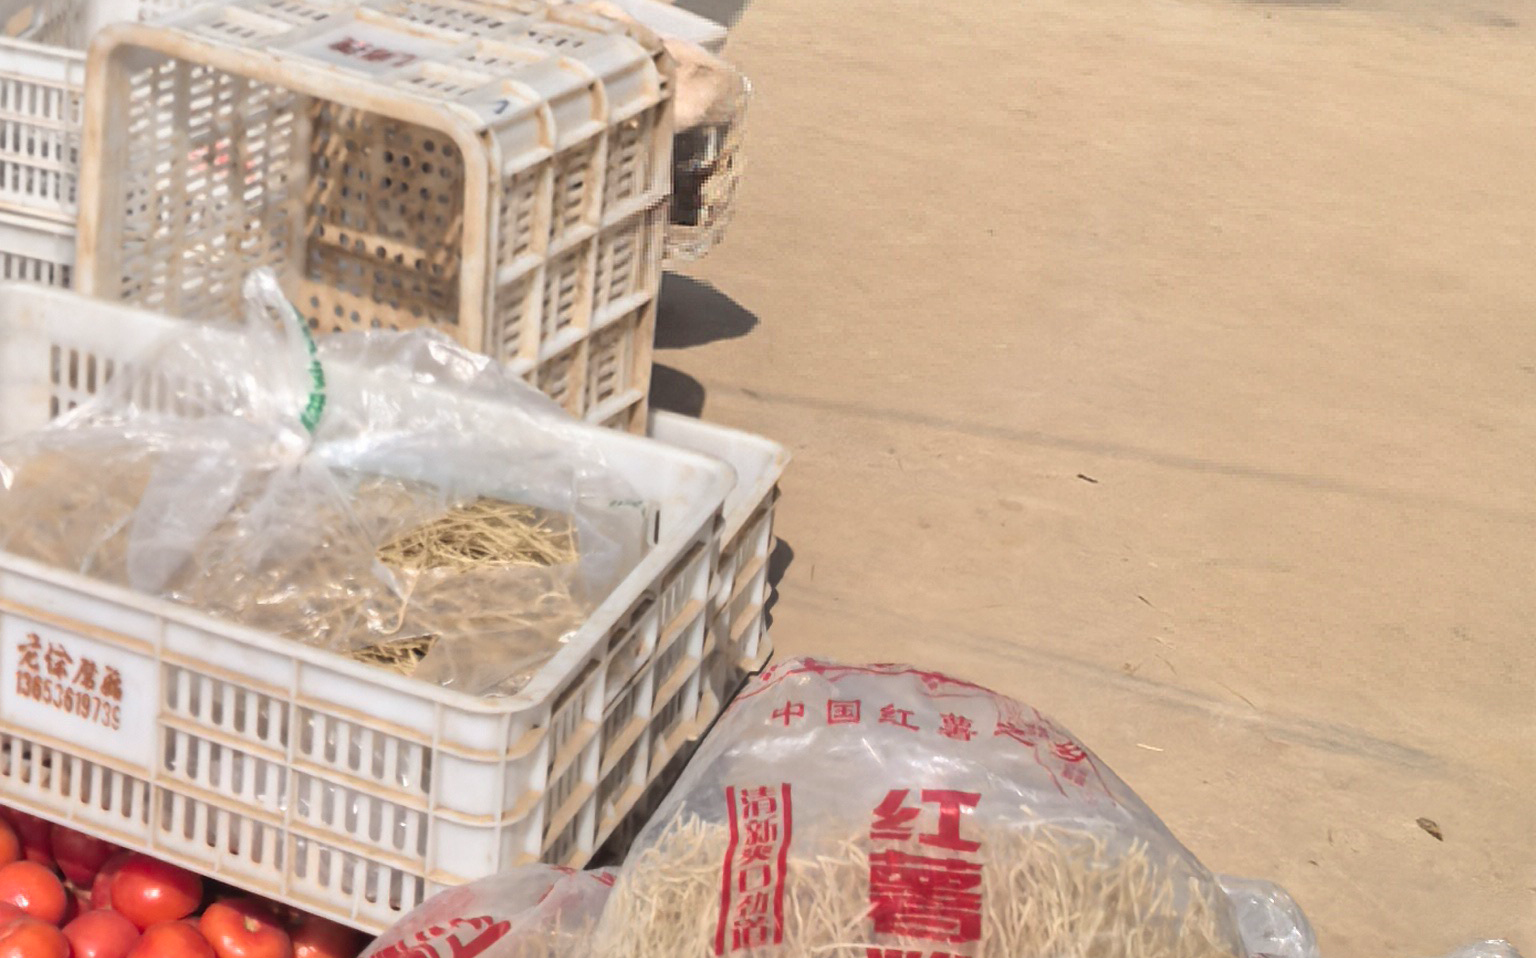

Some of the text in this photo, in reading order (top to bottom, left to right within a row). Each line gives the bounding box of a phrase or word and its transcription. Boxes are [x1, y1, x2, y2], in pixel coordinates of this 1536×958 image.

[771, 699, 1088, 764] 中国红薯之乡
